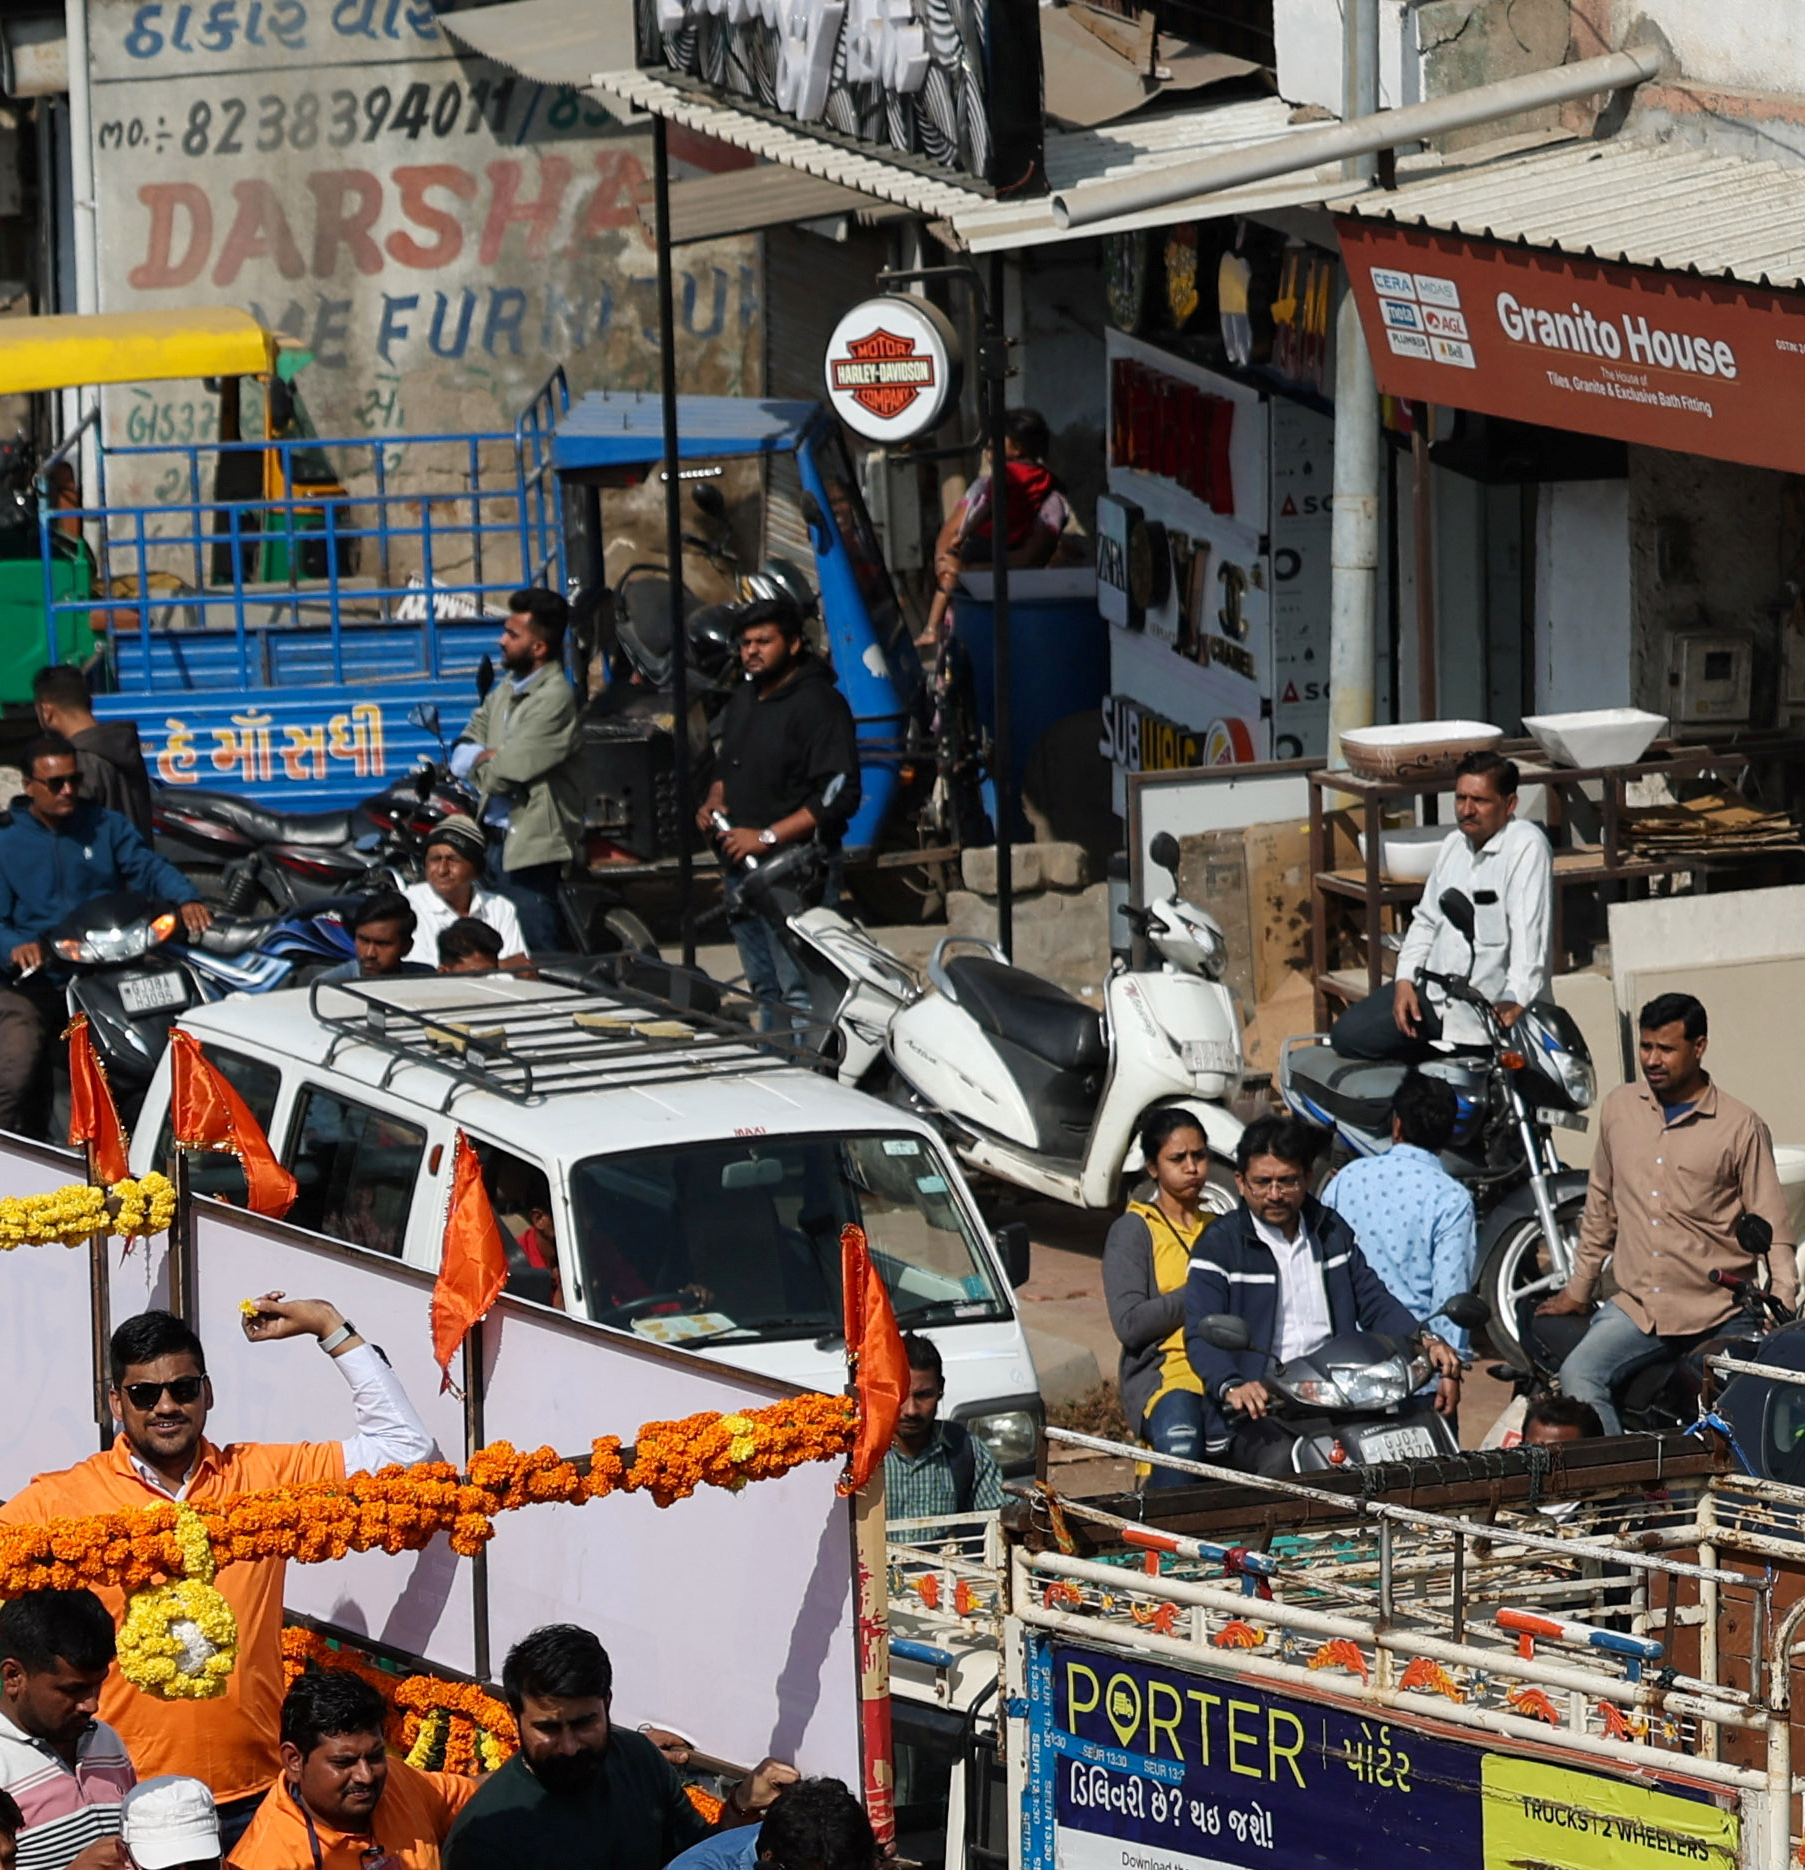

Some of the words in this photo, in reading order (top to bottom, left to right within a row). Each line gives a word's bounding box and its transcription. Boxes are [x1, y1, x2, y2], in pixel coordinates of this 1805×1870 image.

[1374, 273, 1412, 292] CERA
[1442, 316, 1465, 334] AGL
[1496, 292, 1621, 359] Granito
[1622, 314, 1738, 379] House
[857, 336, 905, 357] MOTOR
[837, 361, 929, 385] HARLEY-DAVIDSON
[1600, 366, 1614, 379] The
[1616, 370, 1639, 384] House
[1640, 375, 1648, 385] of
[860, 388, 910, 412] COMPANY
[1547, 371, 1573, 392] Tiles,
[1573, 376, 1606, 397] Granite
[1607, 385, 1614, 397] &
[1616, 383, 1658, 405] Exclusive
[1658, 391, 1680, 408] Bath
[1681, 397, 1713, 418] Fitting
[158, 718, 199, 783] હે
[1067, 1662, 1306, 1789] PORTER
[1083, 1745, 1105, 1765] SEUR
[1106, 1750, 1127, 1768] 13:30
[1144, 1760, 1166, 1778] SEUR
[1070, 1761, 1145, 1820] ડિલિવરી
[1151, 1779, 1183, 1827] છે?
[1227, 1801, 1274, 1850] જશે!
[1523, 1799, 1589, 1832] TRUCKS
[1602, 1819, 1612, 1838] 2
[1616, 1819, 1709, 1862] WHEELERS
